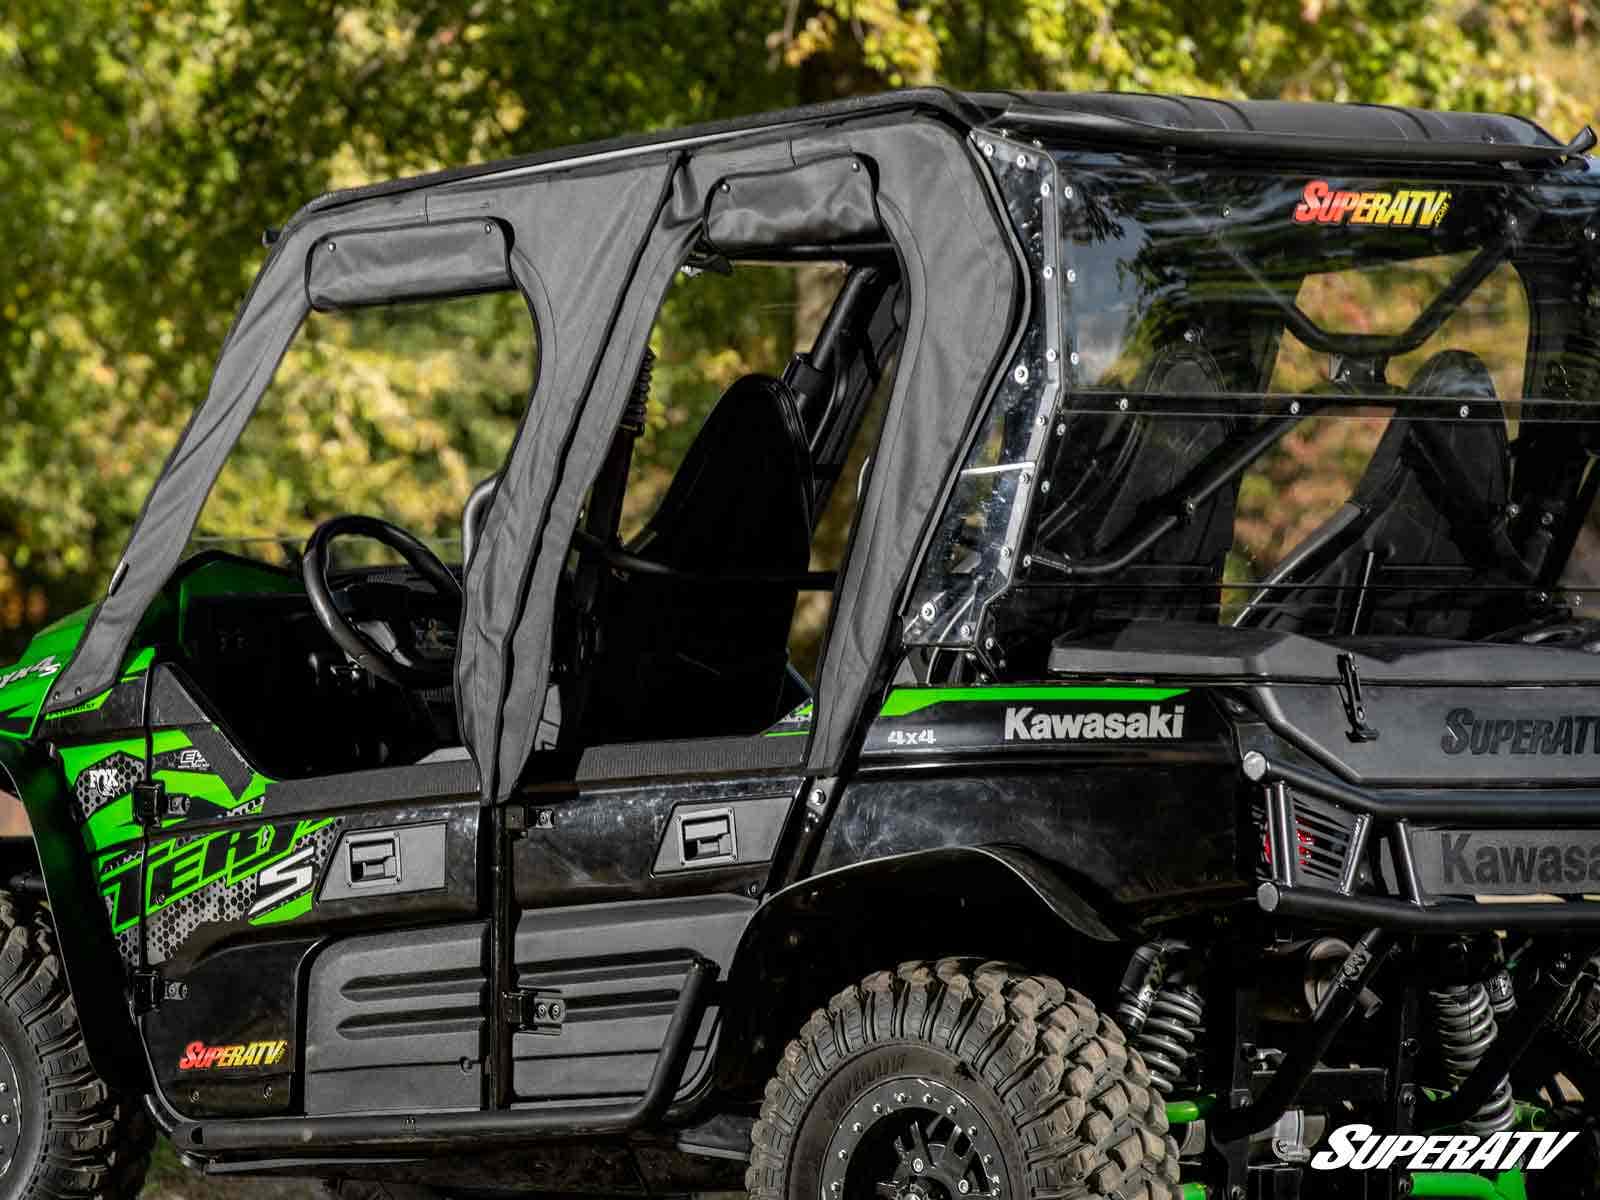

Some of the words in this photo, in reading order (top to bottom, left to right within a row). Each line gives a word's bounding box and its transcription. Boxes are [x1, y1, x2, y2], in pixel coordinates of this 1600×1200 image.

[887, 729, 937, 745] 4x4
[1004, 706, 1184, 740] Kawasaki
[89, 768, 119, 797] FOX
